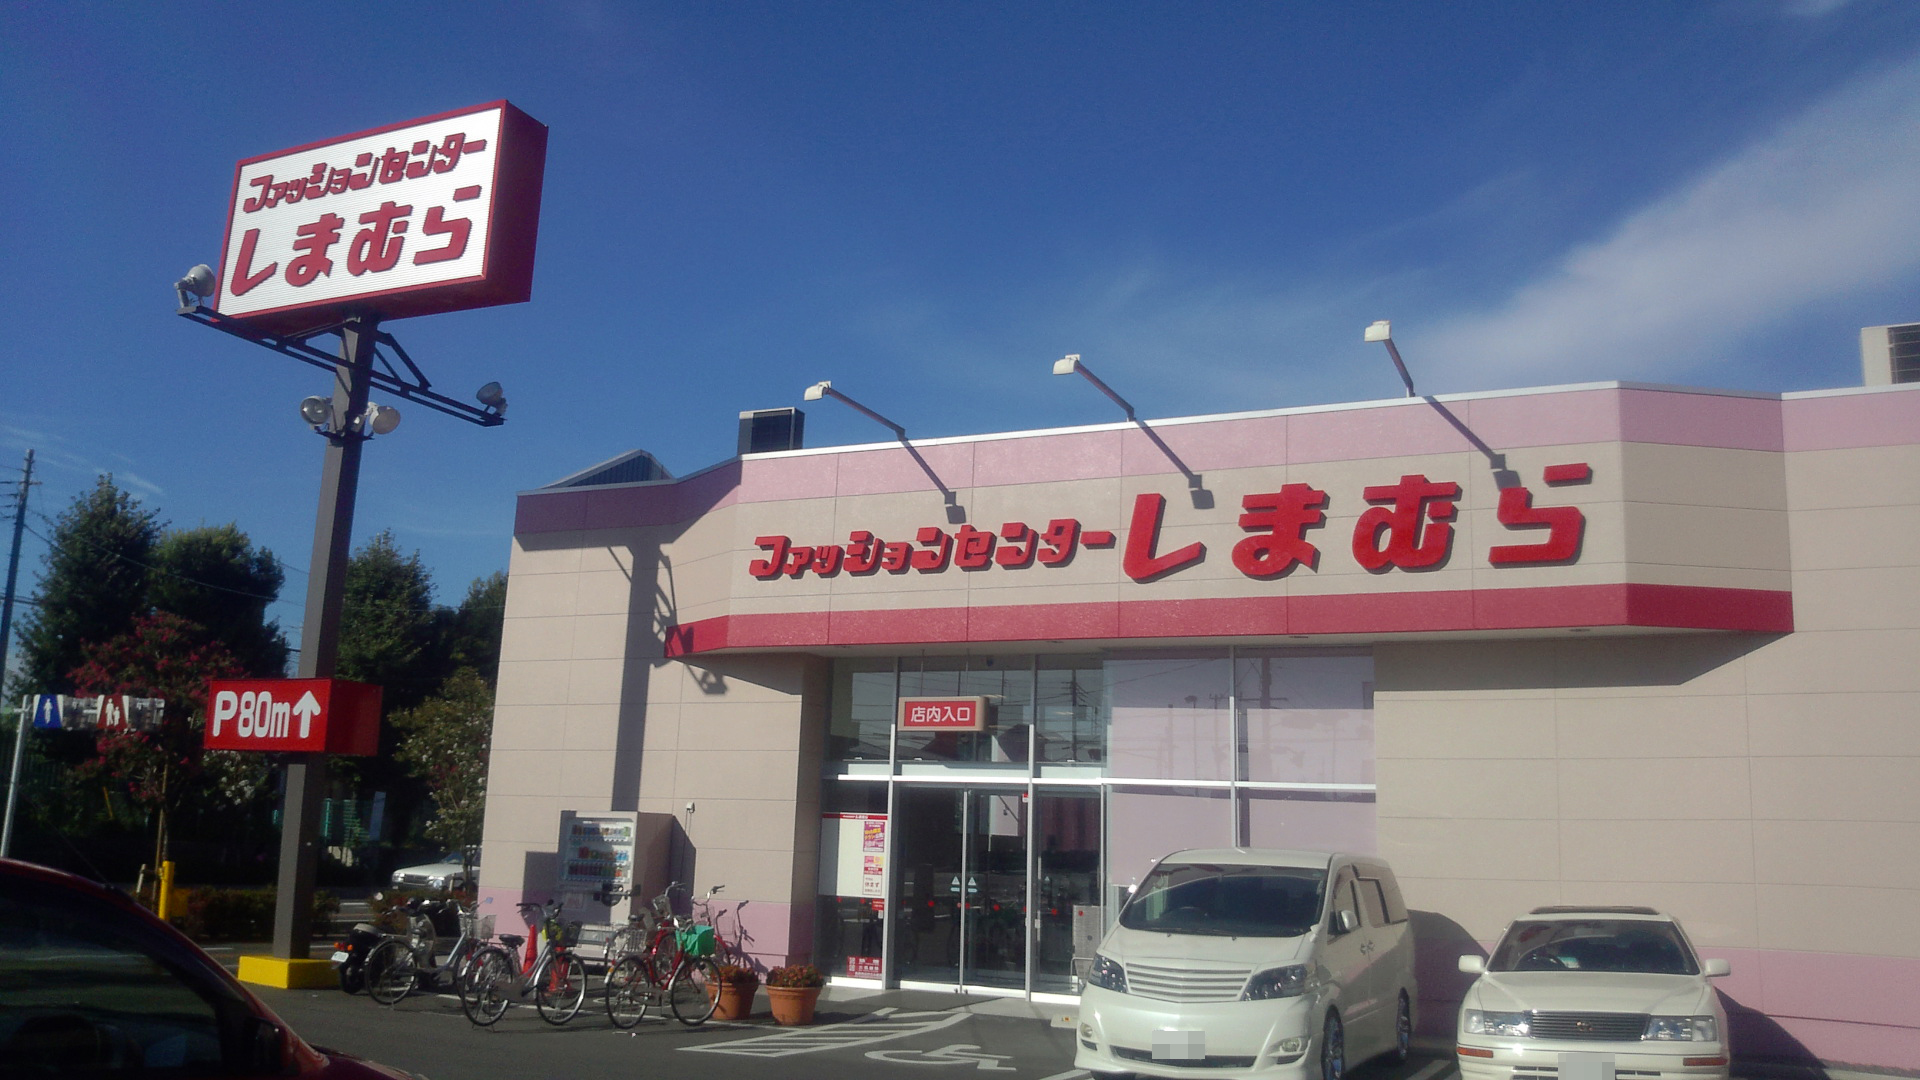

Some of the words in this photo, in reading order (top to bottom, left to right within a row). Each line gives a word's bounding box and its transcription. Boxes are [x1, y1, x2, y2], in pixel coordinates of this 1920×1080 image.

[243, 132, 487, 213] ファッションセンター
[230, 185, 482, 297] しまむら
[749, 519, 1115, 578] ファッションセンター
[1123, 463, 1591, 581] しまむら
[910, 705, 971, 723] 店内入口
